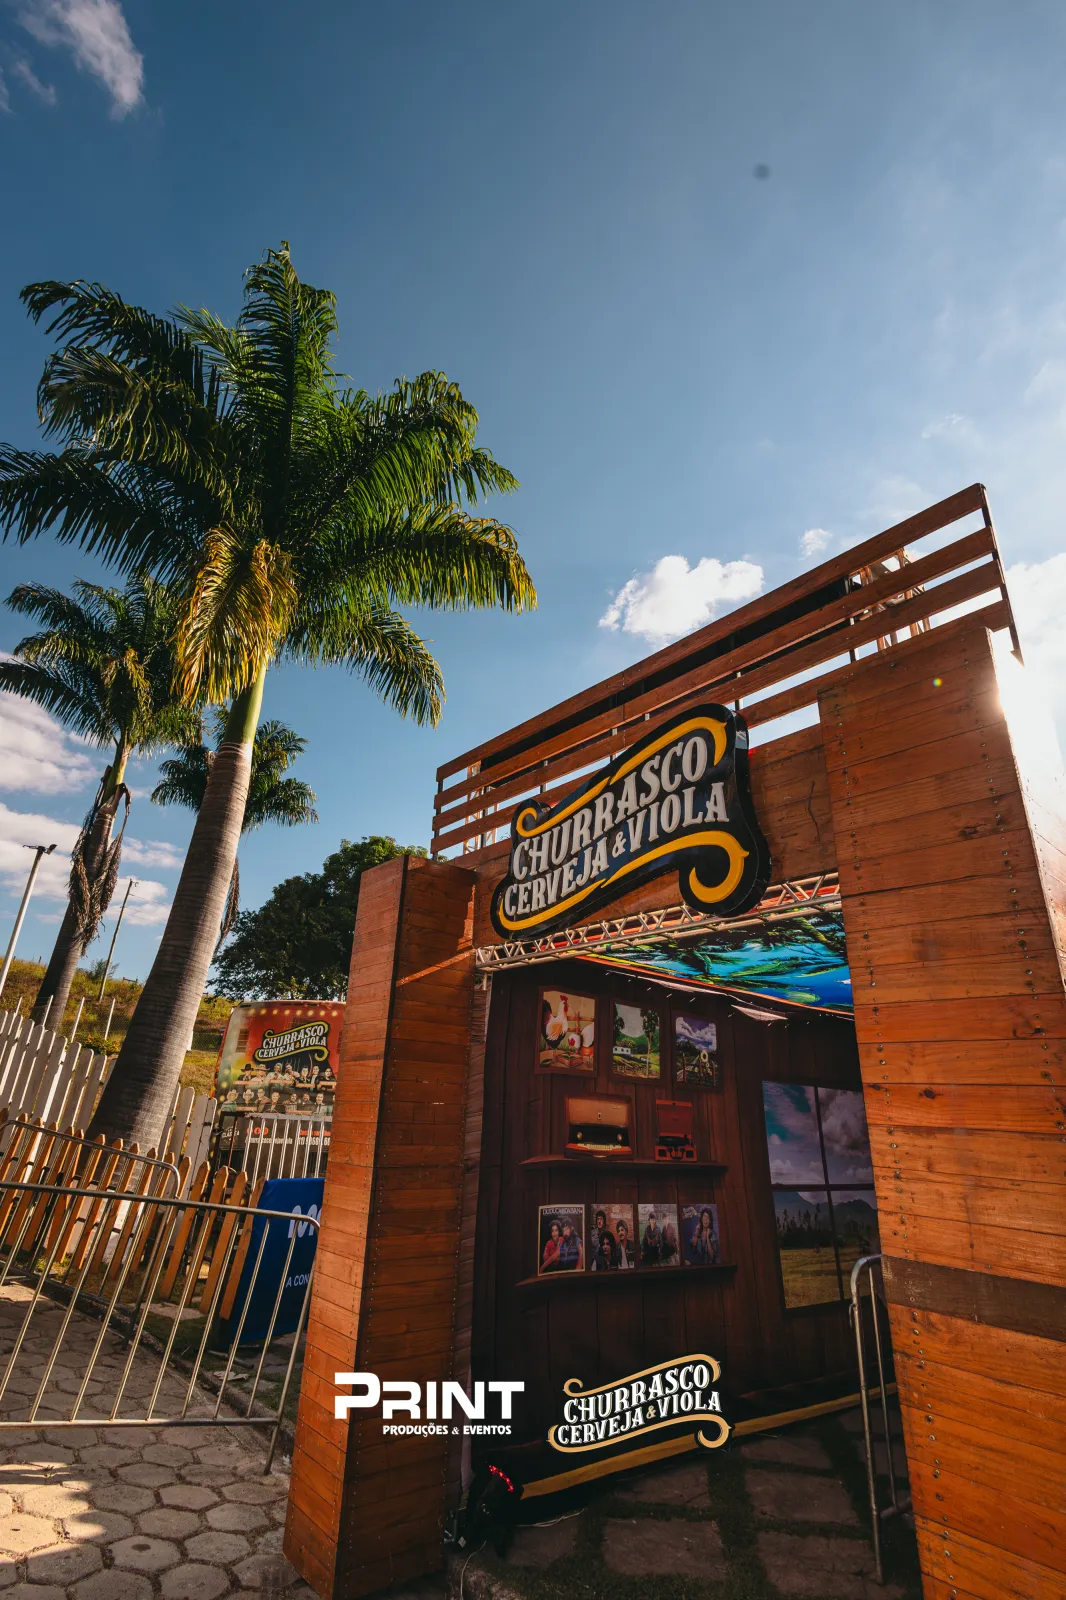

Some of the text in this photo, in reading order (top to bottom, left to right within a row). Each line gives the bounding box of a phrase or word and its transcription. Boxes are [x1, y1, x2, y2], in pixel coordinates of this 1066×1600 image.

[512, 736, 708, 880] CHURRASCO
[504, 782, 729, 917] CERVEJA & VIOLA
[258, 1042, 295, 1059] CERVEJA
[300, 1036, 327, 1048] VIOLA
[262, 1025, 324, 1049] CHURRASCO
[285, 1276, 292, 1288] A
